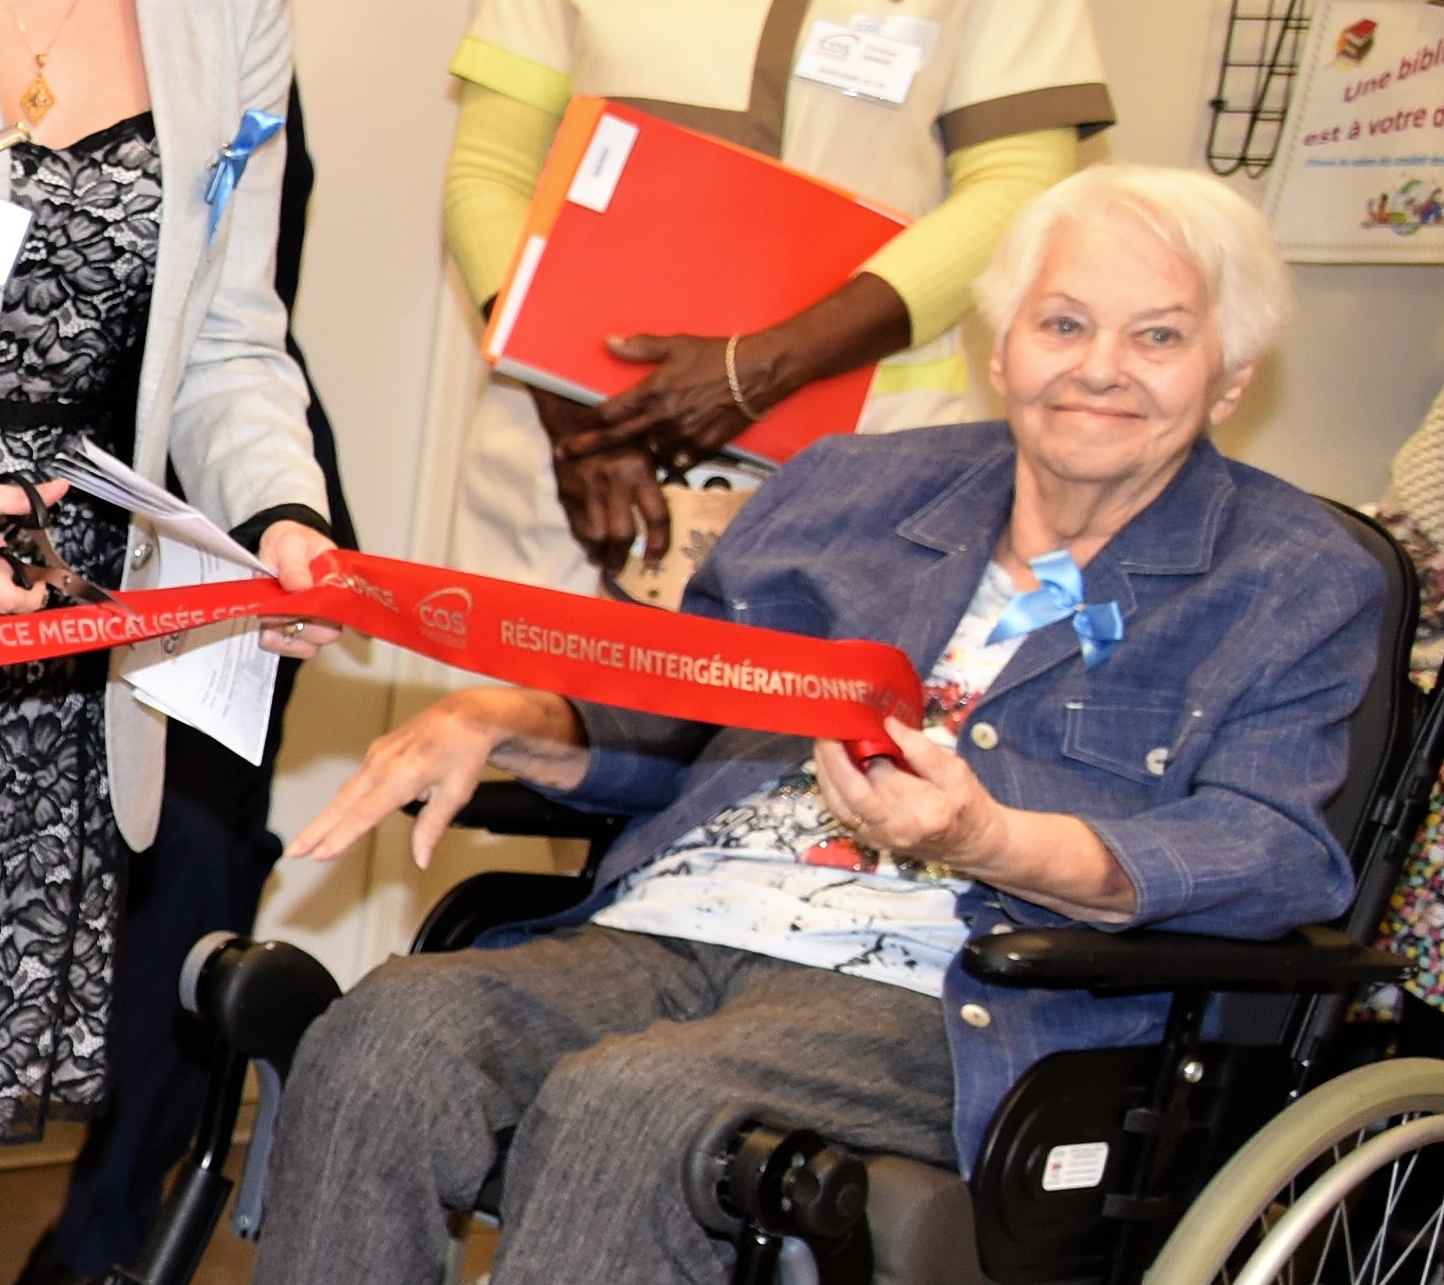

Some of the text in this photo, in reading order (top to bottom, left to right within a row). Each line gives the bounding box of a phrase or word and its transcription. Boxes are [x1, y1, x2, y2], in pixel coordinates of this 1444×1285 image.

[1342, 69, 1393, 104] Une
[1303, 125, 1341, 147] est
[1369, 105, 1428, 138] votre
[419, 604, 468, 636] COS
[501, 616, 625, 669] RÉSIDENCE
